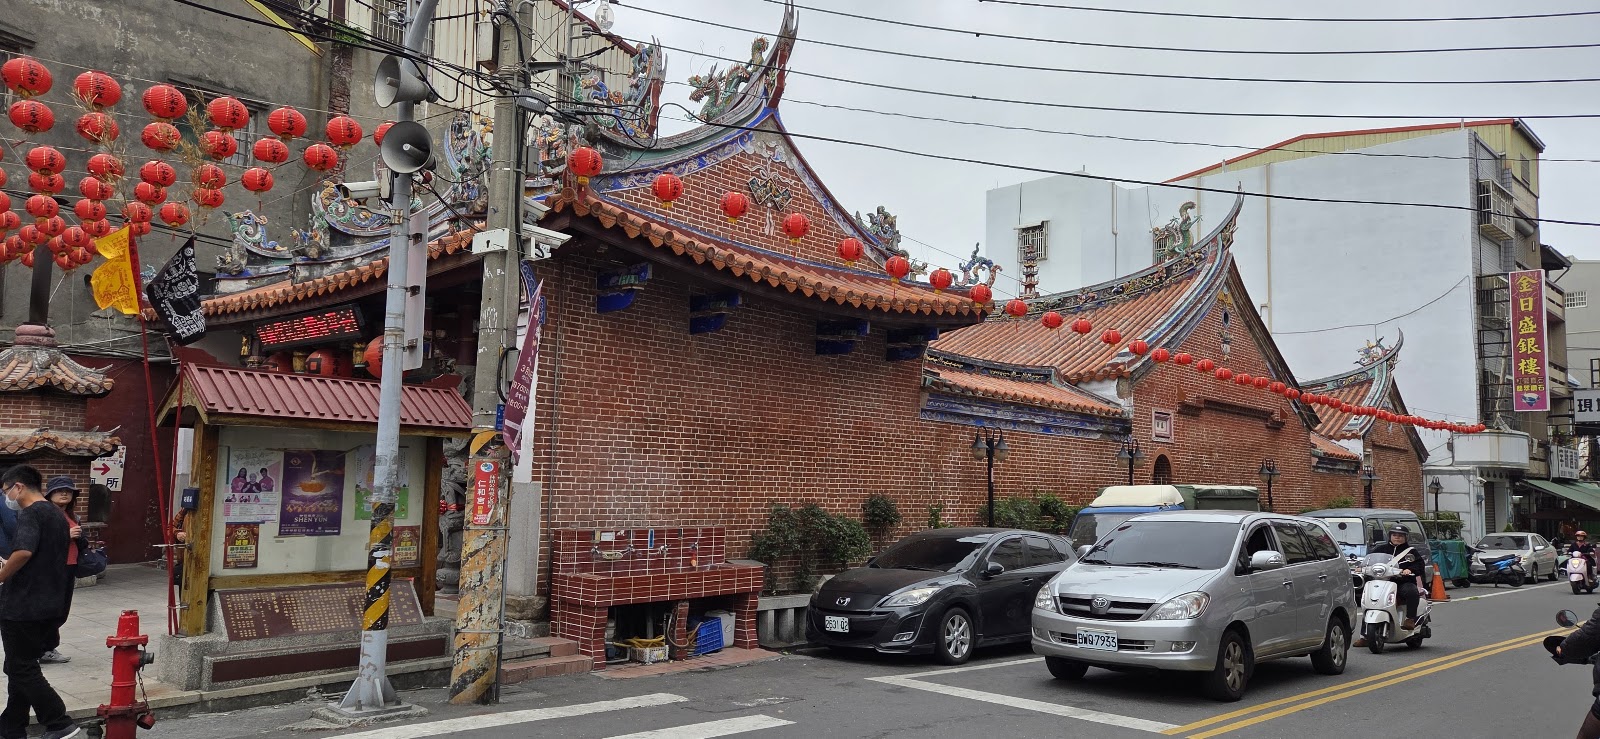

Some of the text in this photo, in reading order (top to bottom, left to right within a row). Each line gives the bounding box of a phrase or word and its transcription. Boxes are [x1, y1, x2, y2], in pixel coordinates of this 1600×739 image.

[1516, 275, 1542, 377] 金日盛銀樓
[1576, 398, 1600, 413] 現
[477, 480, 487, 505] 仁和宮
